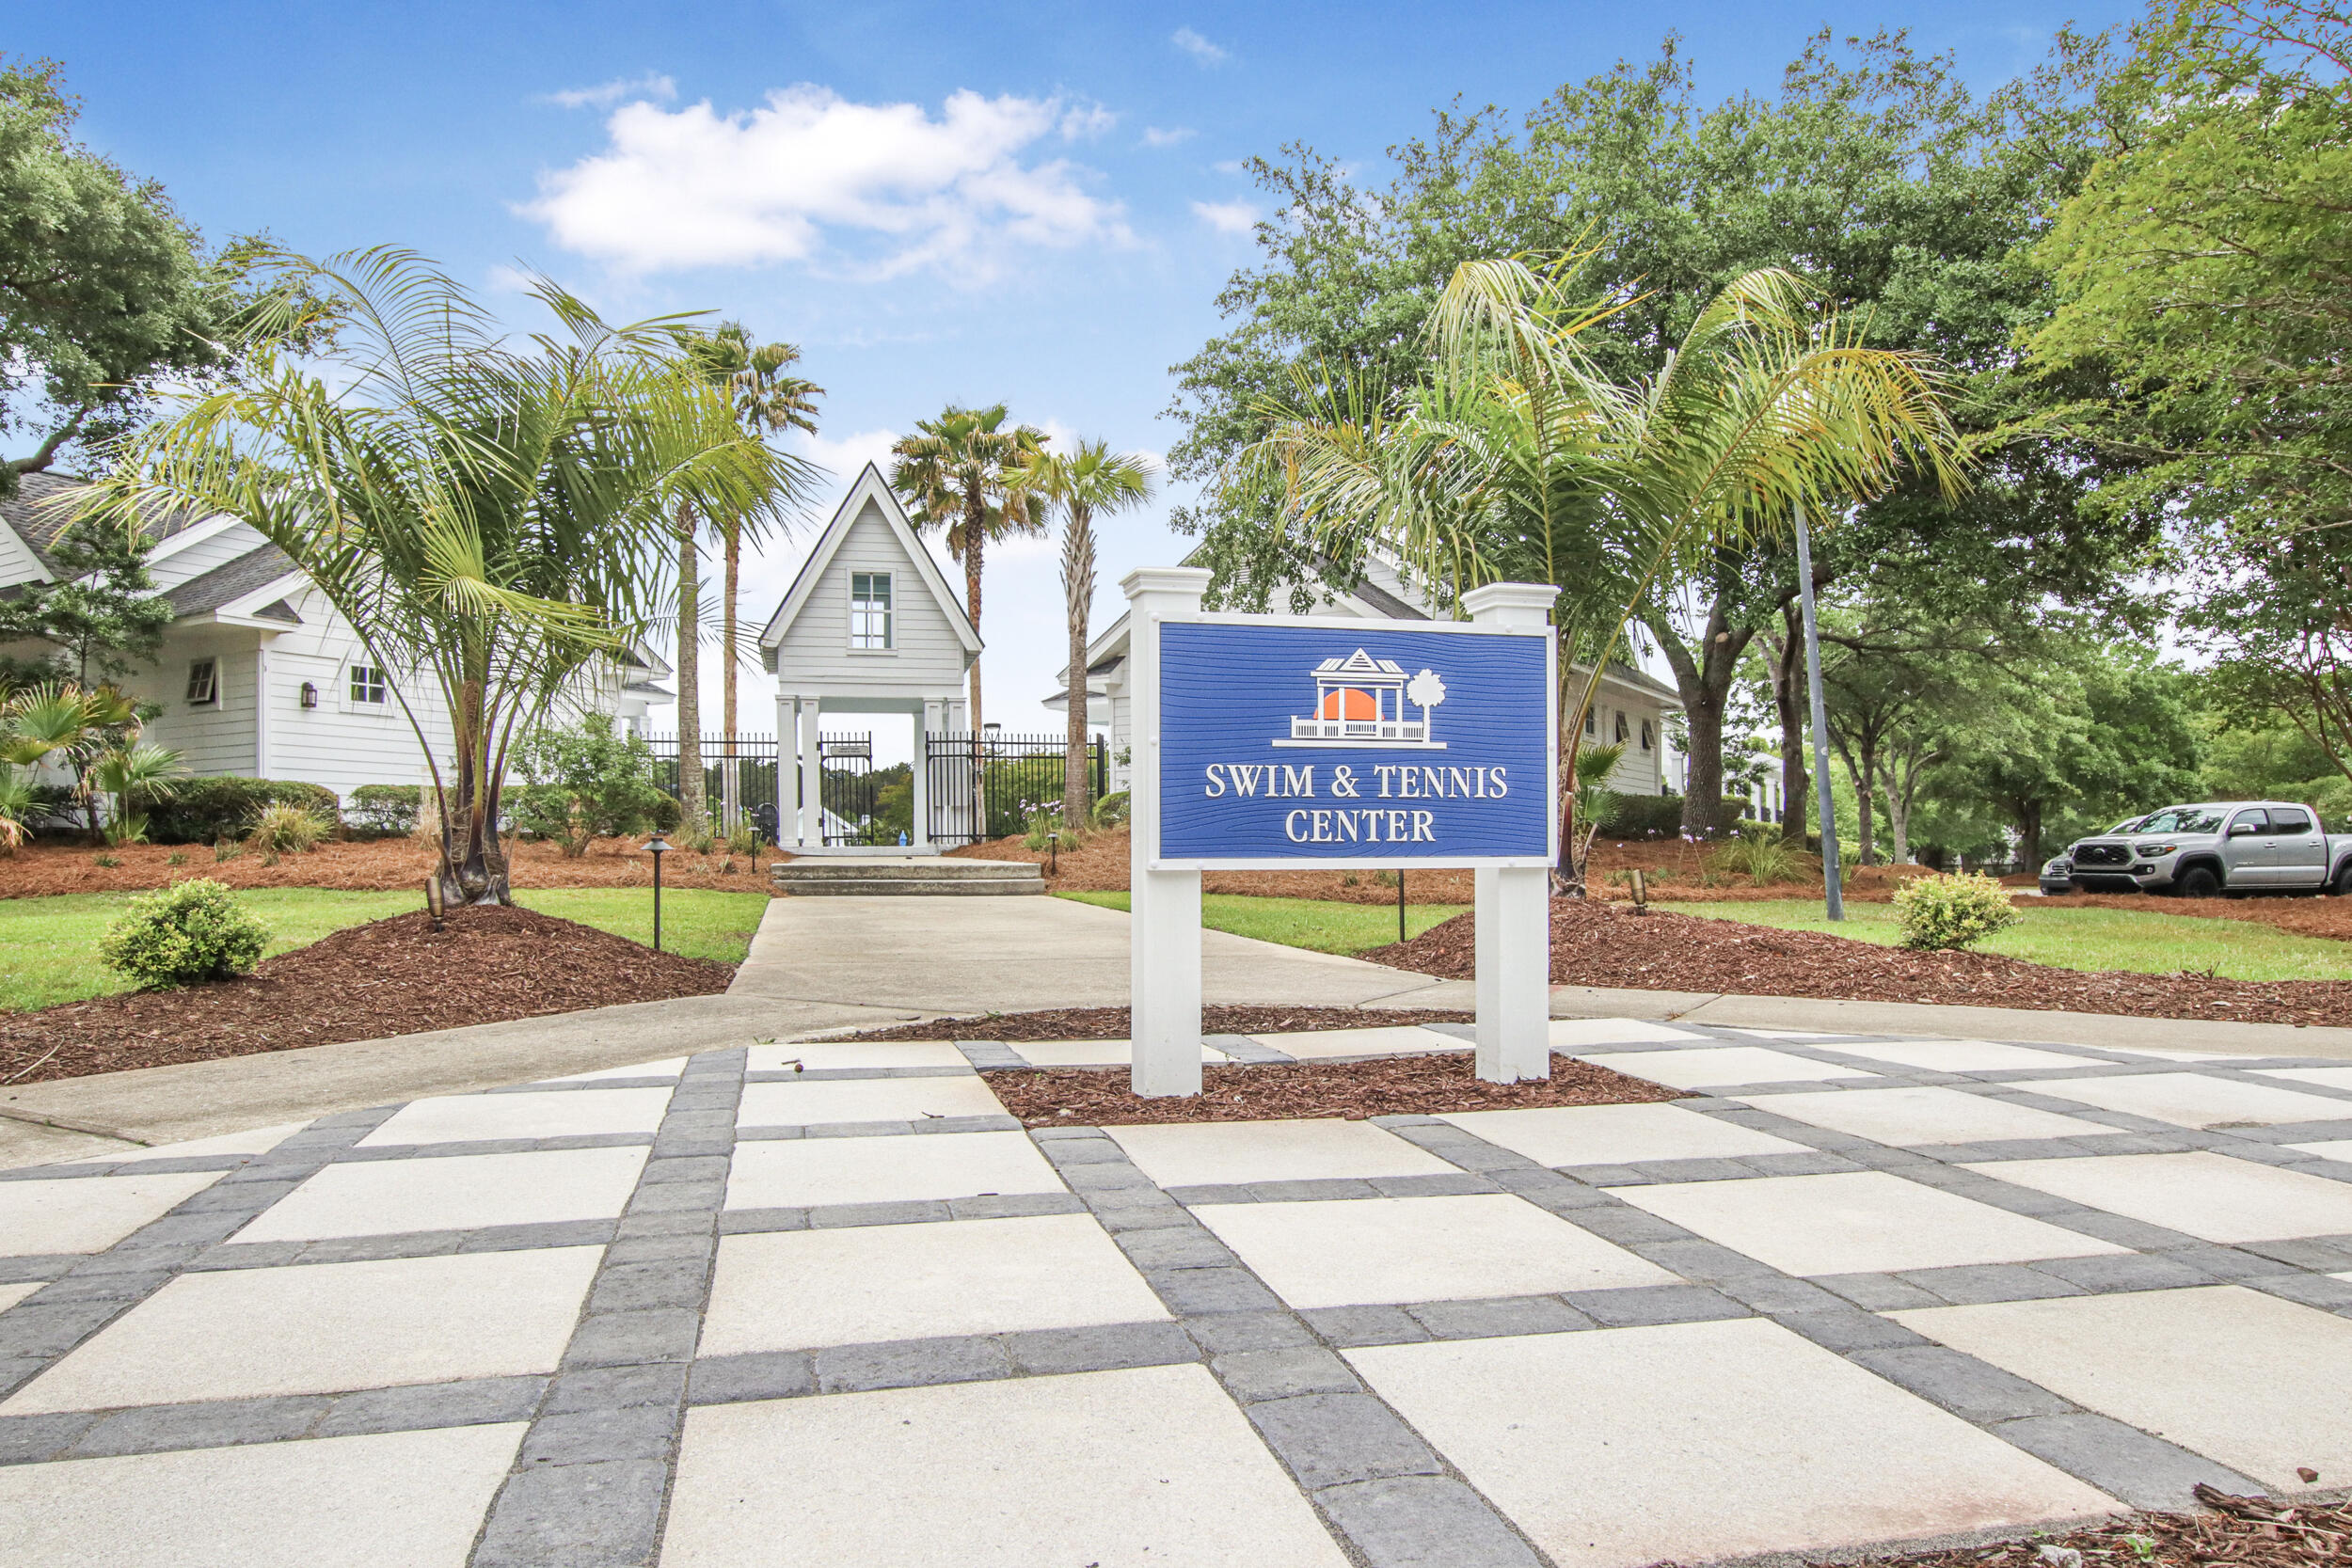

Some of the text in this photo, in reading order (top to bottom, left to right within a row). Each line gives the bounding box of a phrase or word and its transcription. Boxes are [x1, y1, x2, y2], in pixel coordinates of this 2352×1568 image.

[1205, 763, 1508, 799] SWIM & TENNIS
[1285, 809, 1437, 843] CENTER
